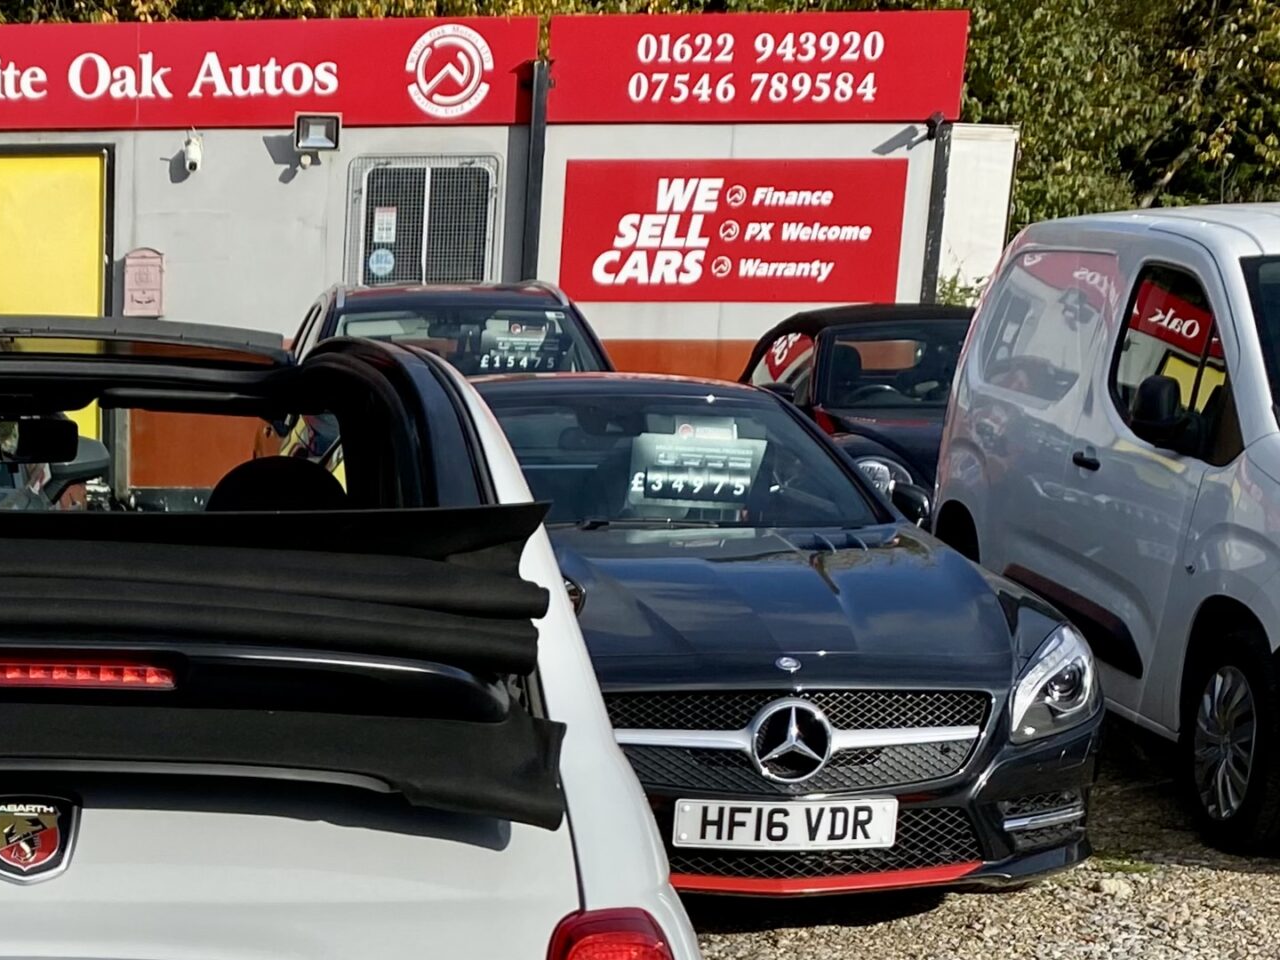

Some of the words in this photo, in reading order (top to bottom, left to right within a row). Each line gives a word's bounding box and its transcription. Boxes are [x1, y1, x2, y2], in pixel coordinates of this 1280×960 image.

[637, 33, 735, 64] 01622
[754, 31, 884, 63] 943920
[68, 51, 174, 101] Oak
[188, 51, 338, 99] Autos
[628, 72, 736, 103] 07546
[750, 72, 877, 103] 789584
[656, 178, 724, 213] WE
[751, 188, 833, 207] Finance
[613, 213, 710, 249] SELL
[744, 222, 772, 241] PX
[781, 222, 872, 241] Welcome
[592, 250, 704, 285] CARS
[738, 258, 834, 282] Warranty
[480, 354, 555, 369] £15475
[631, 472, 745, 496] £34975
[699, 805, 790, 842] HF16
[805, 805, 873, 842] VDR
